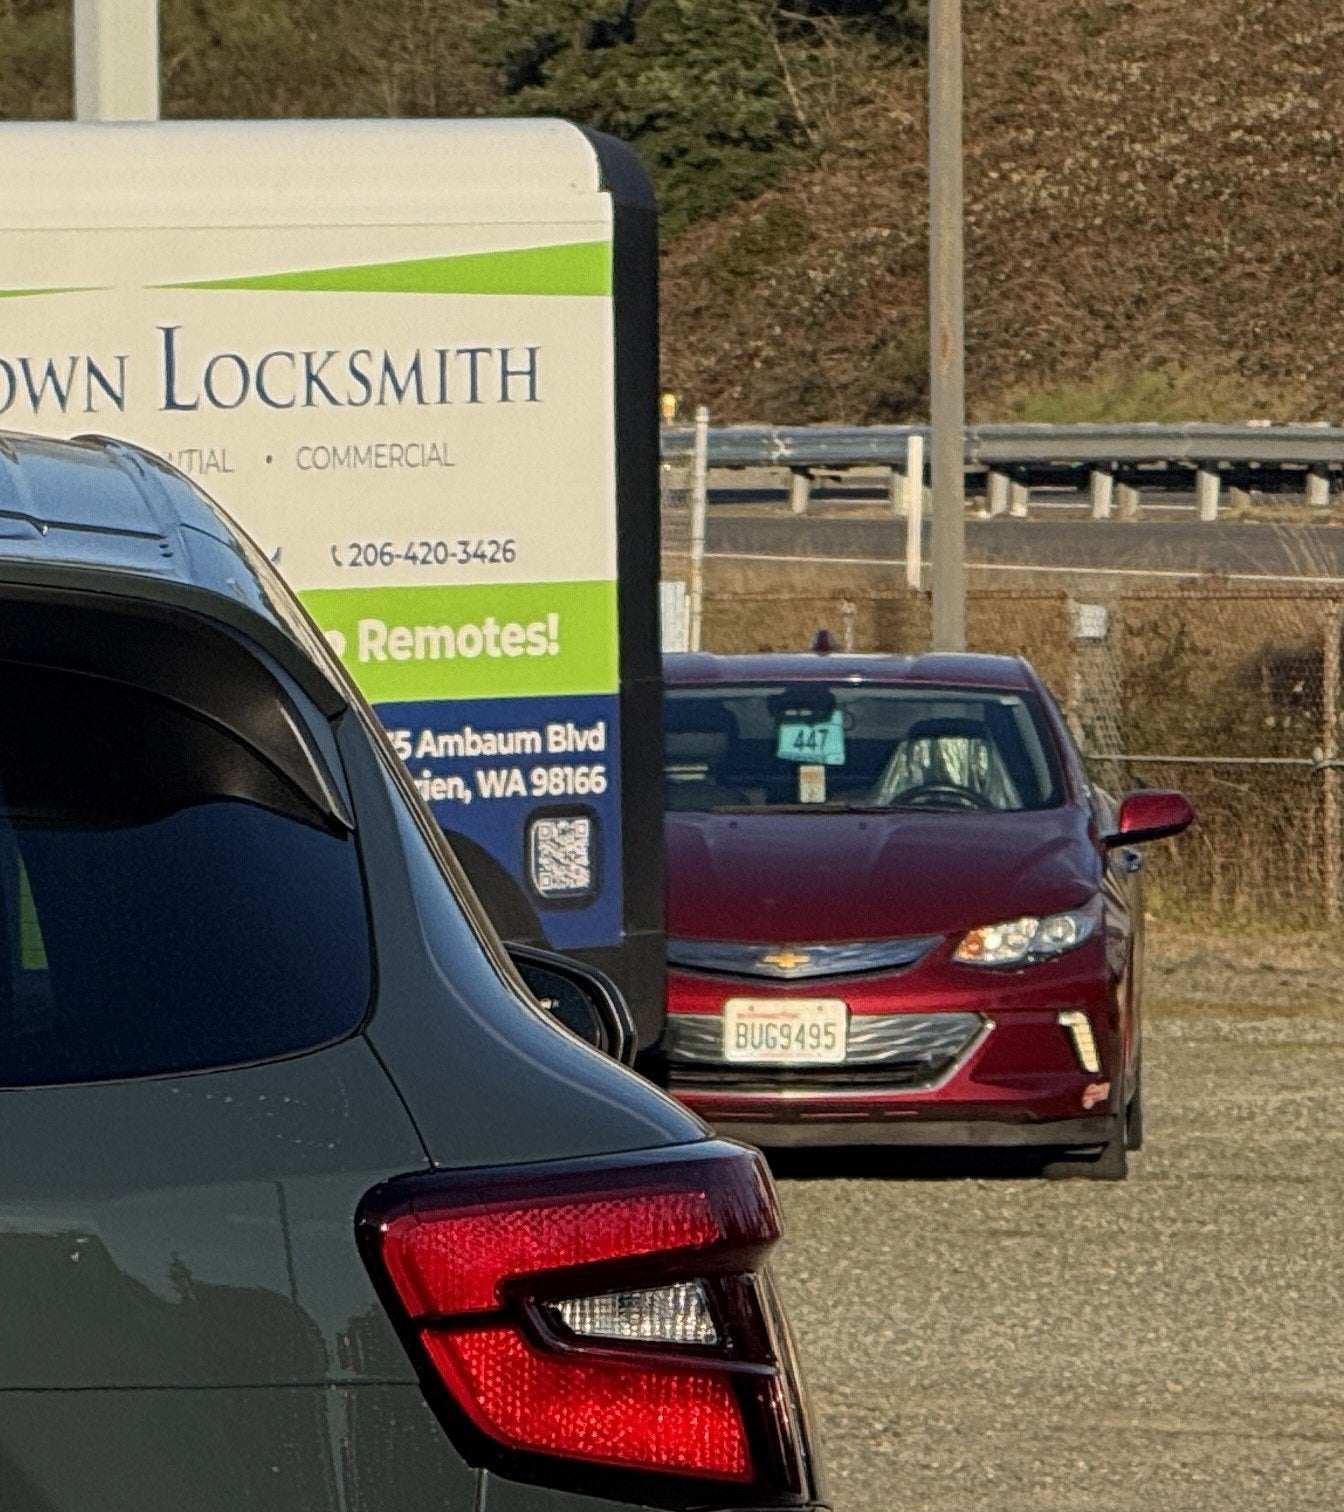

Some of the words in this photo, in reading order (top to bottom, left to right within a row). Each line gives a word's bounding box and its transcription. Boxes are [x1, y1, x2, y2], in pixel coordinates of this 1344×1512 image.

[155, 324, 543, 412] LOCKSMITH
[296, 442, 456, 471] COMMERCIAL
[347, 538, 518, 567] 206-420-3426
[357, 612, 560, 663] Remotes!
[416, 726, 542, 759] Ambaum
[546, 721, 607, 754] Blvd
[793, 728, 829, 753] 447
[476, 768, 528, 799] WA
[530, 765, 609, 797] 98166
[735, 1021, 838, 1051] BUG9495
